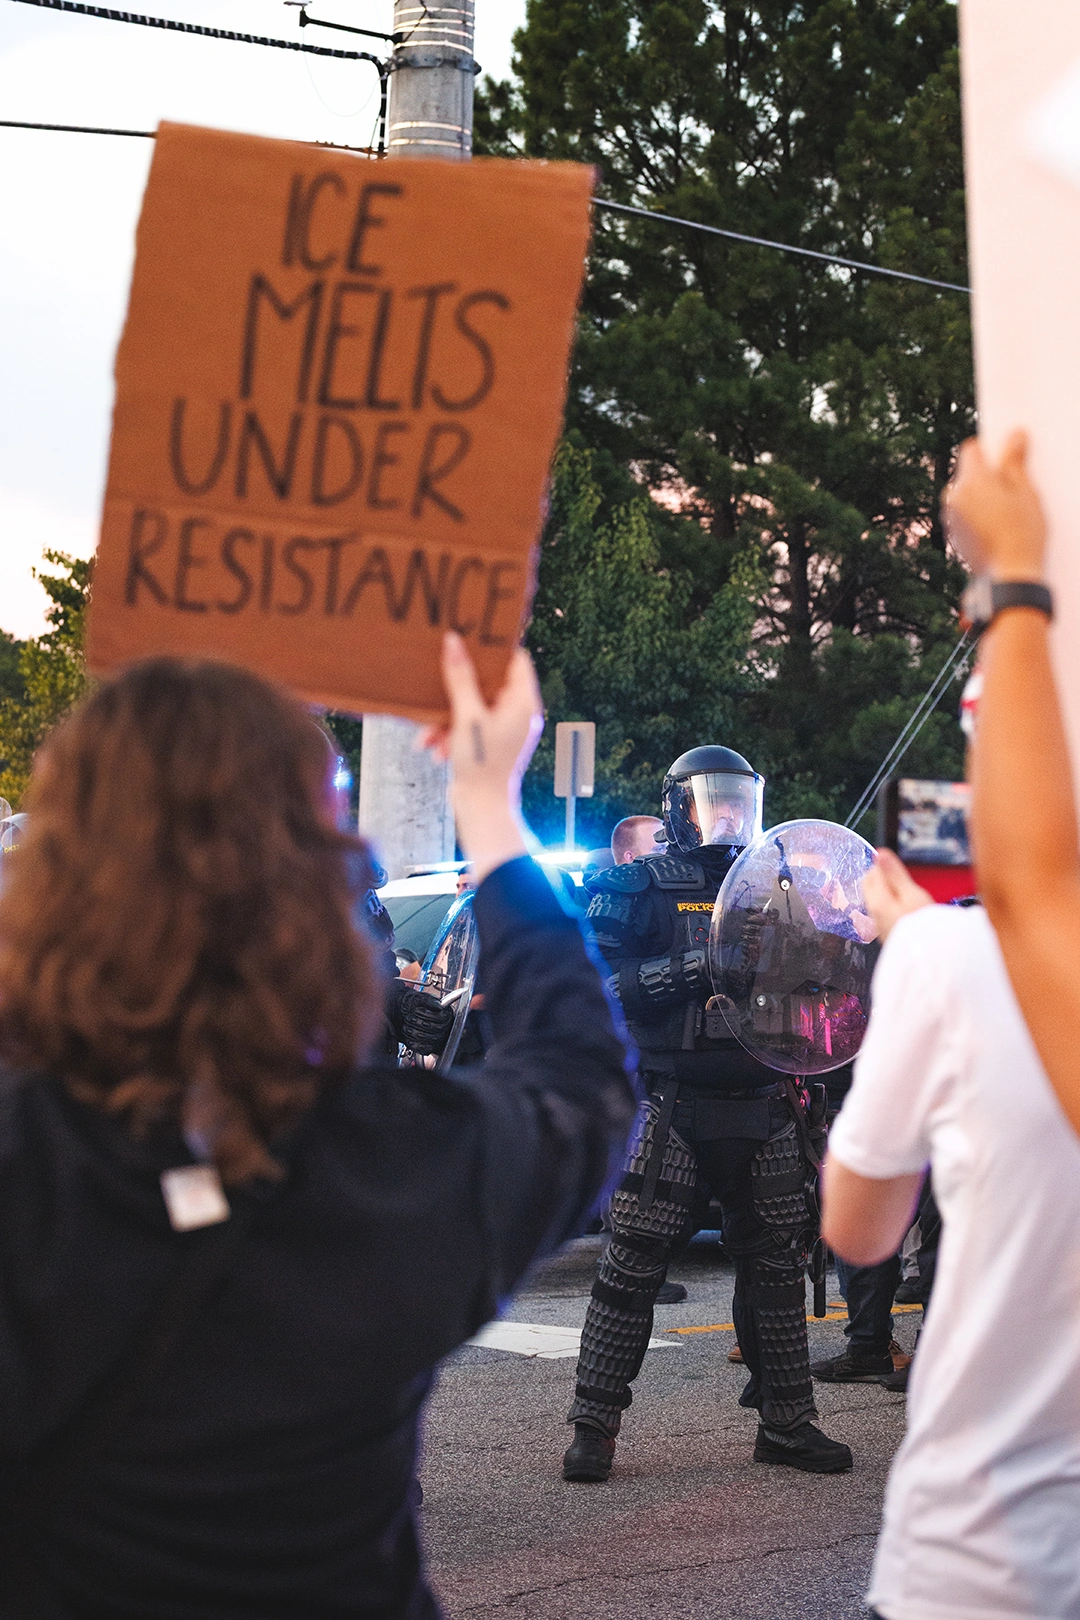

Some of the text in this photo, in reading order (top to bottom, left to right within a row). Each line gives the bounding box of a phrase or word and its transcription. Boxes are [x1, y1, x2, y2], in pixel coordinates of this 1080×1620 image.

[281, 171, 404, 276] ICE
[239, 270, 511, 412] MELTS
[168, 396, 472, 524] UNDER
[123, 506, 523, 647] RESISTANCE
[677, 903, 717, 912] POLIC
